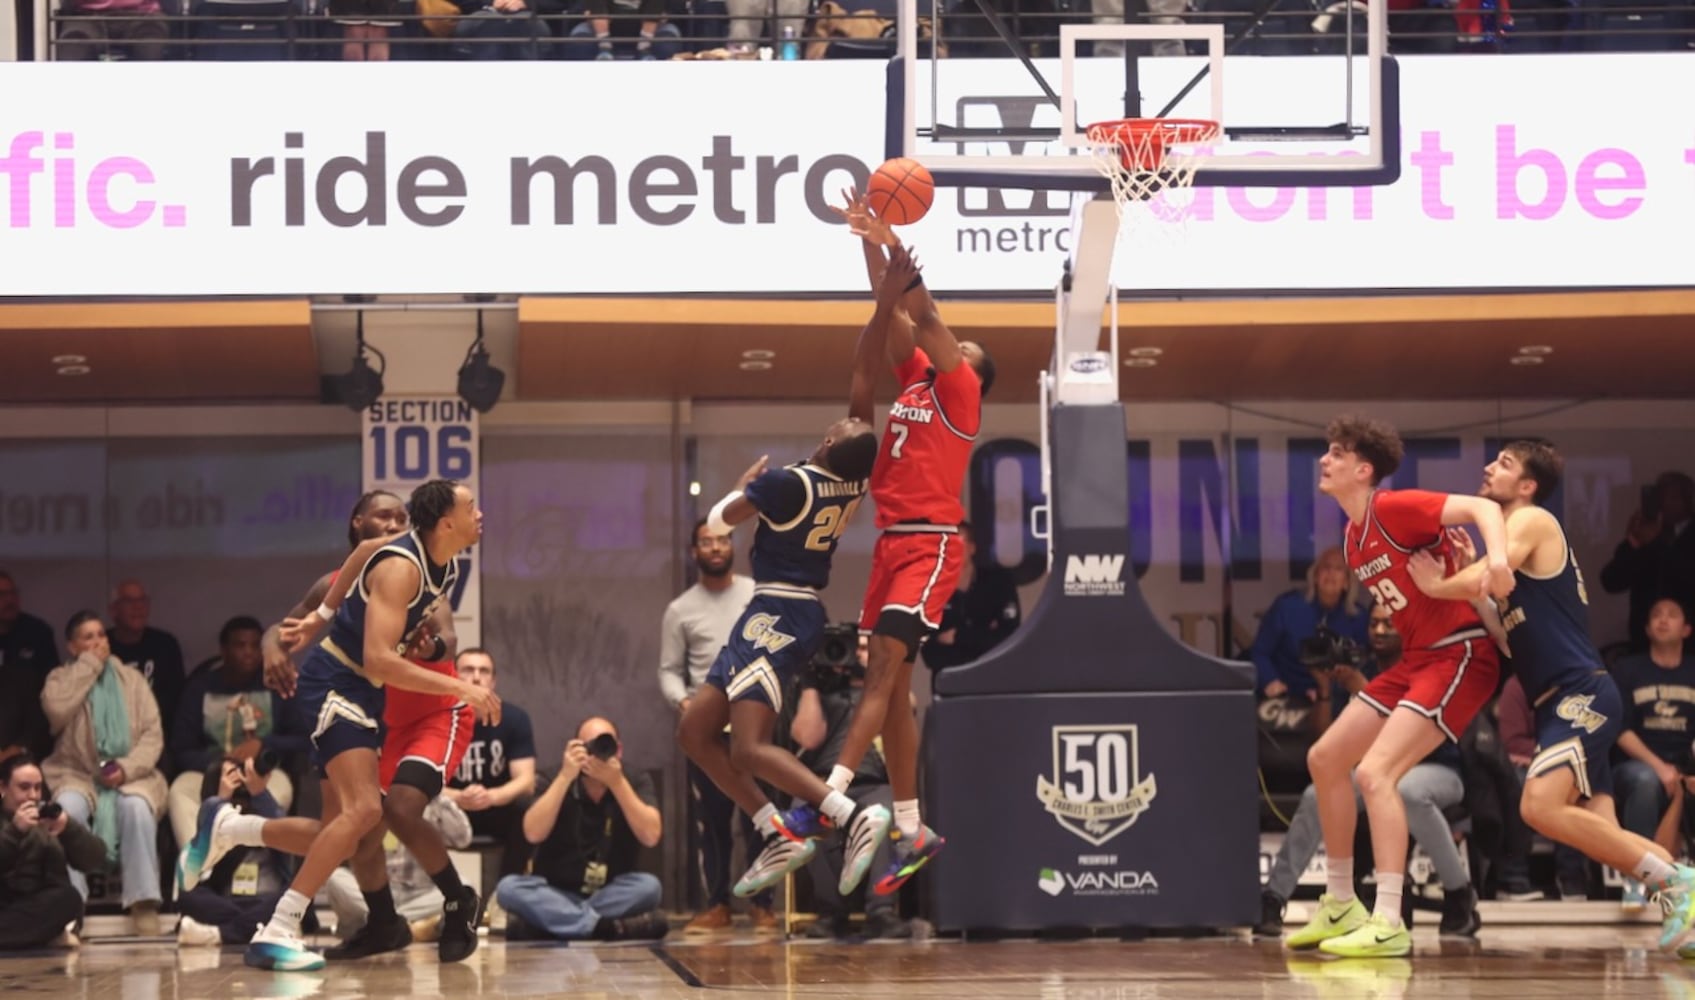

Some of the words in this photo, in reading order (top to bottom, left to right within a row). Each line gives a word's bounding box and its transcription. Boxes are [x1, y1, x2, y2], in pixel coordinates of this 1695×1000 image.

[0, 131, 187, 228] fic.
[230, 131, 468, 228] ride
[510, 135, 872, 226] metro
[1496, 124, 1647, 220] be
[369, 400, 472, 422] SECTION
[370, 426, 472, 480] 106
[890, 422, 909, 458] 7
[1064, 554, 1126, 582] NW
[1368, 577, 1408, 615] 29
[1060, 732, 1128, 803] 50
[1066, 870, 1158, 889] VANDA
